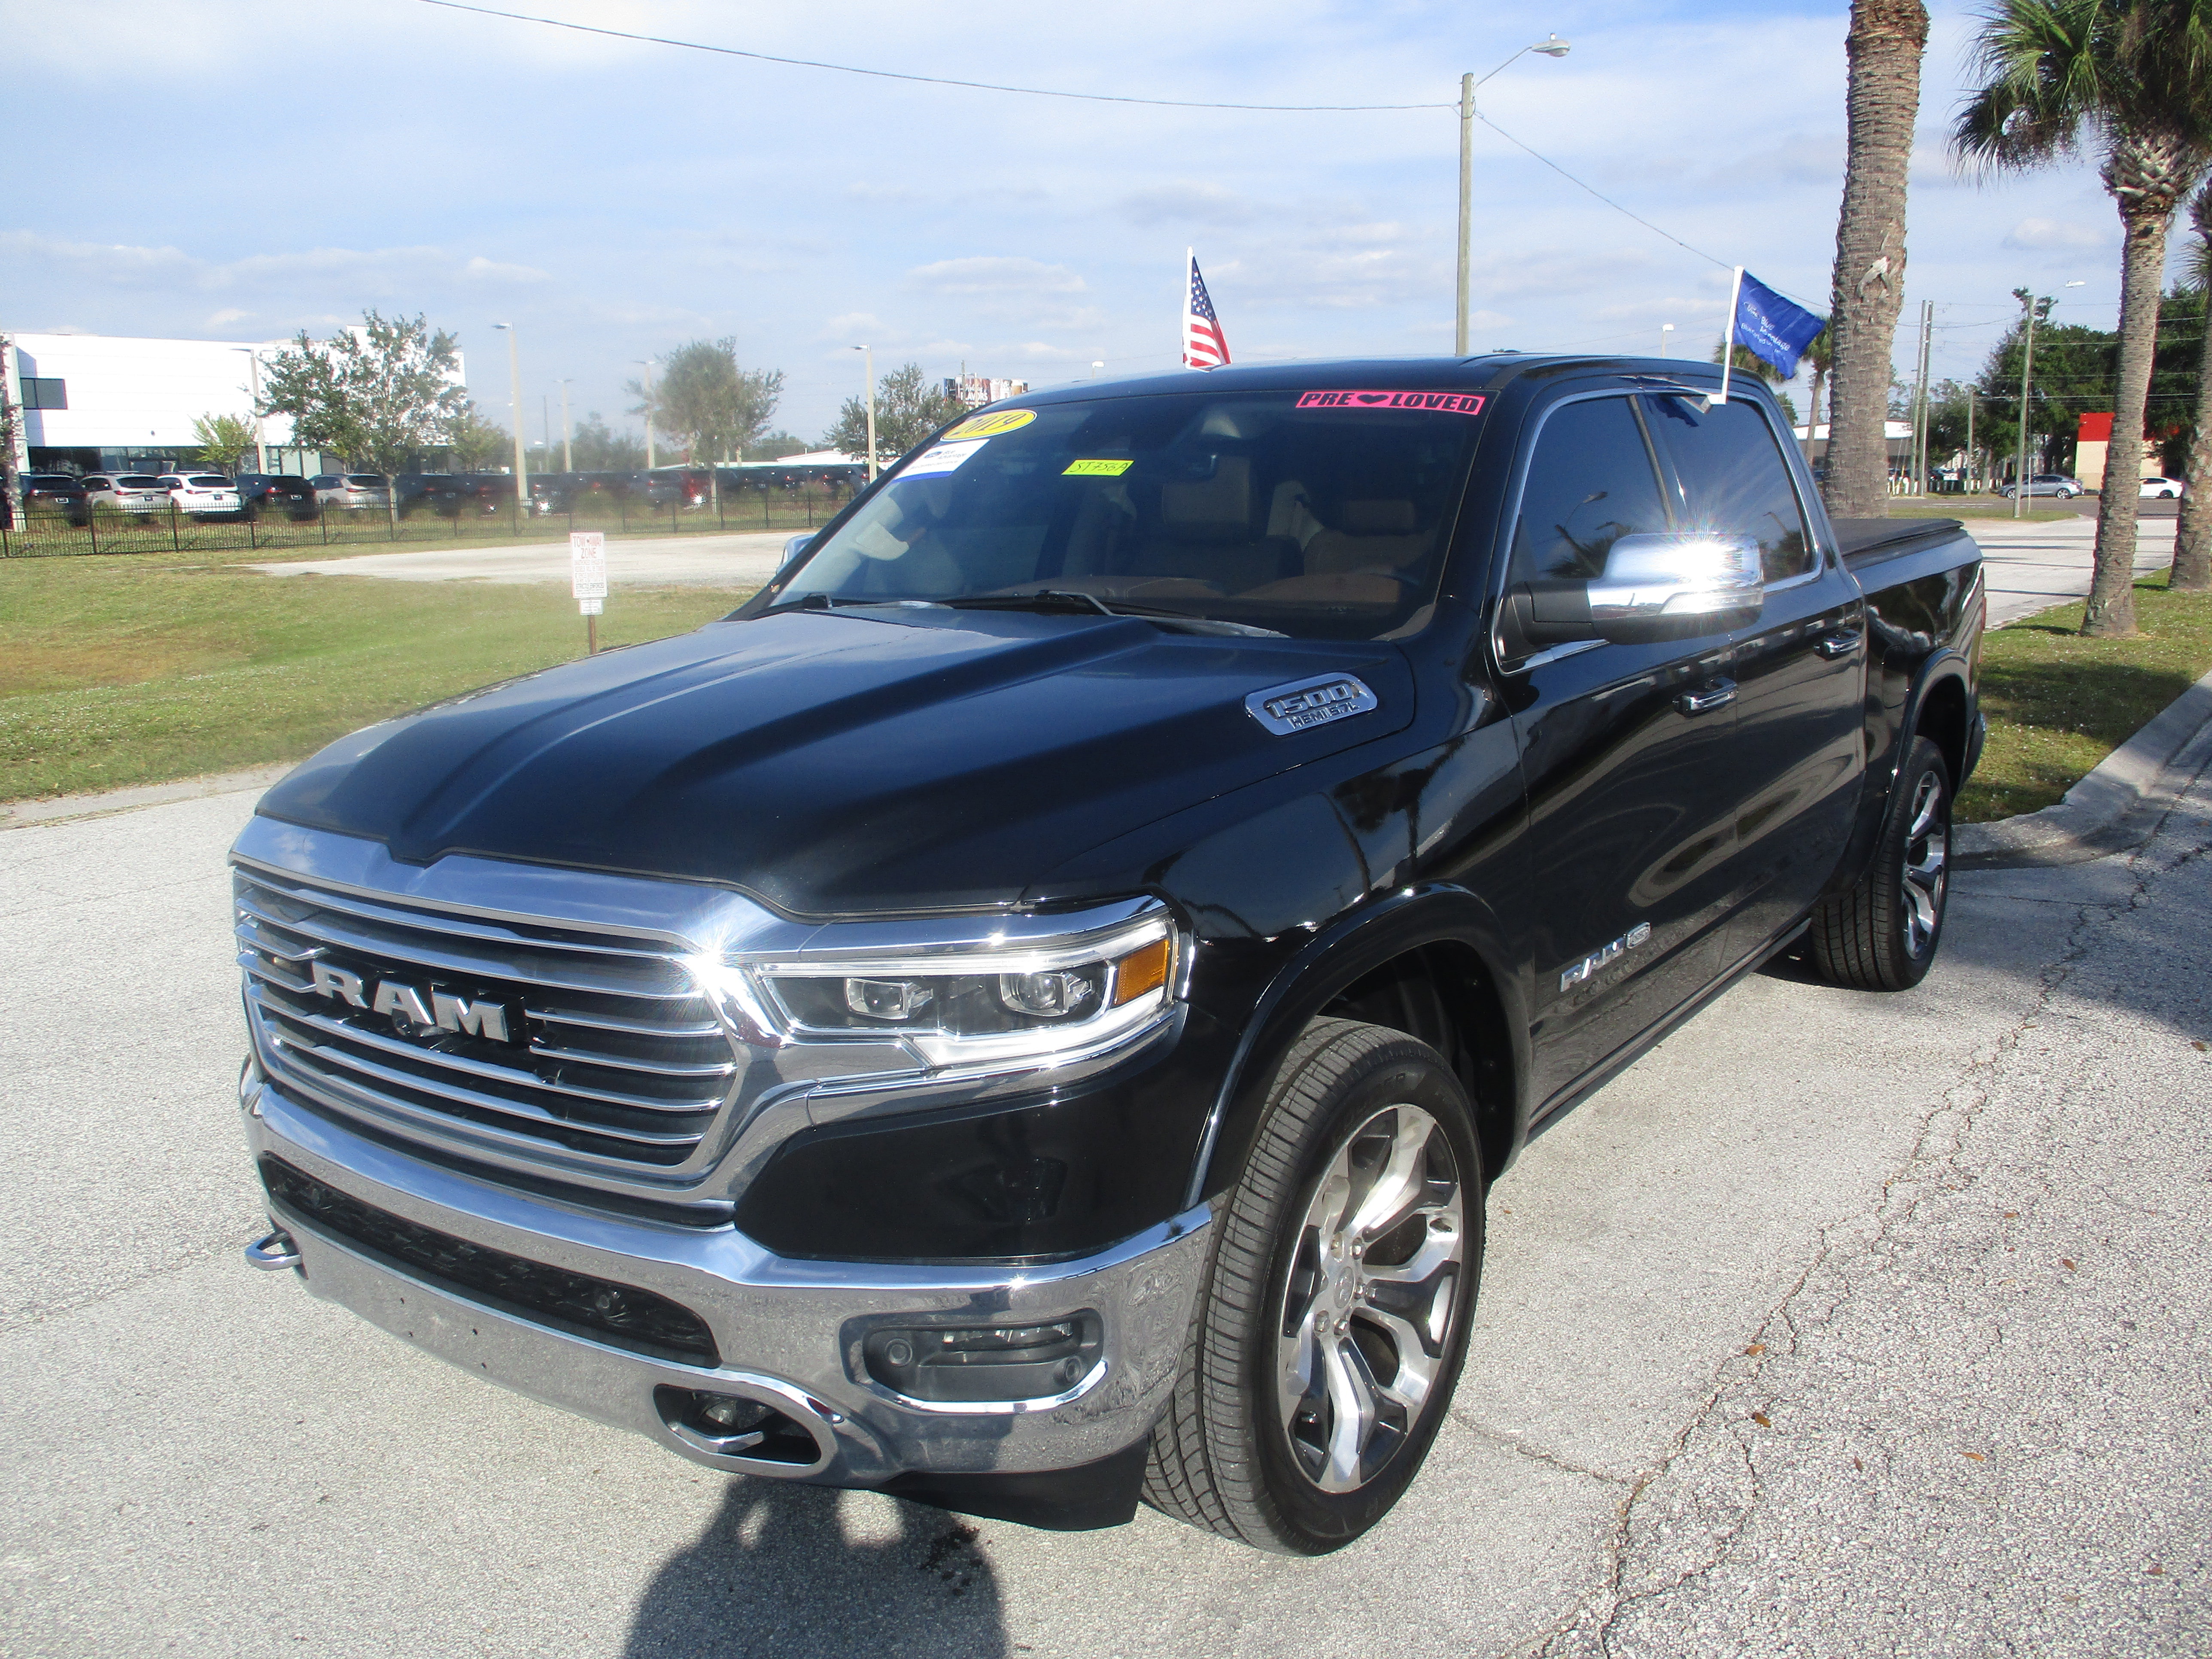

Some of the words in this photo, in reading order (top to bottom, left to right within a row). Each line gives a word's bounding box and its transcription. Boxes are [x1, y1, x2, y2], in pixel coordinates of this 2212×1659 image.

[960, 392, 988, 401] AVORS
[1300, 392, 1355, 406] PRE
[1389, 394, 1479, 412] LOVED
[950, 413, 1027, 436] 2019
[581, 547, 597, 559] ZONE
[1267, 683, 1353, 719] 1500
[1287, 708, 1330, 729] HEMI
[1560, 936, 1626, 992] RAM
[312, 960, 509, 1042] RAM
